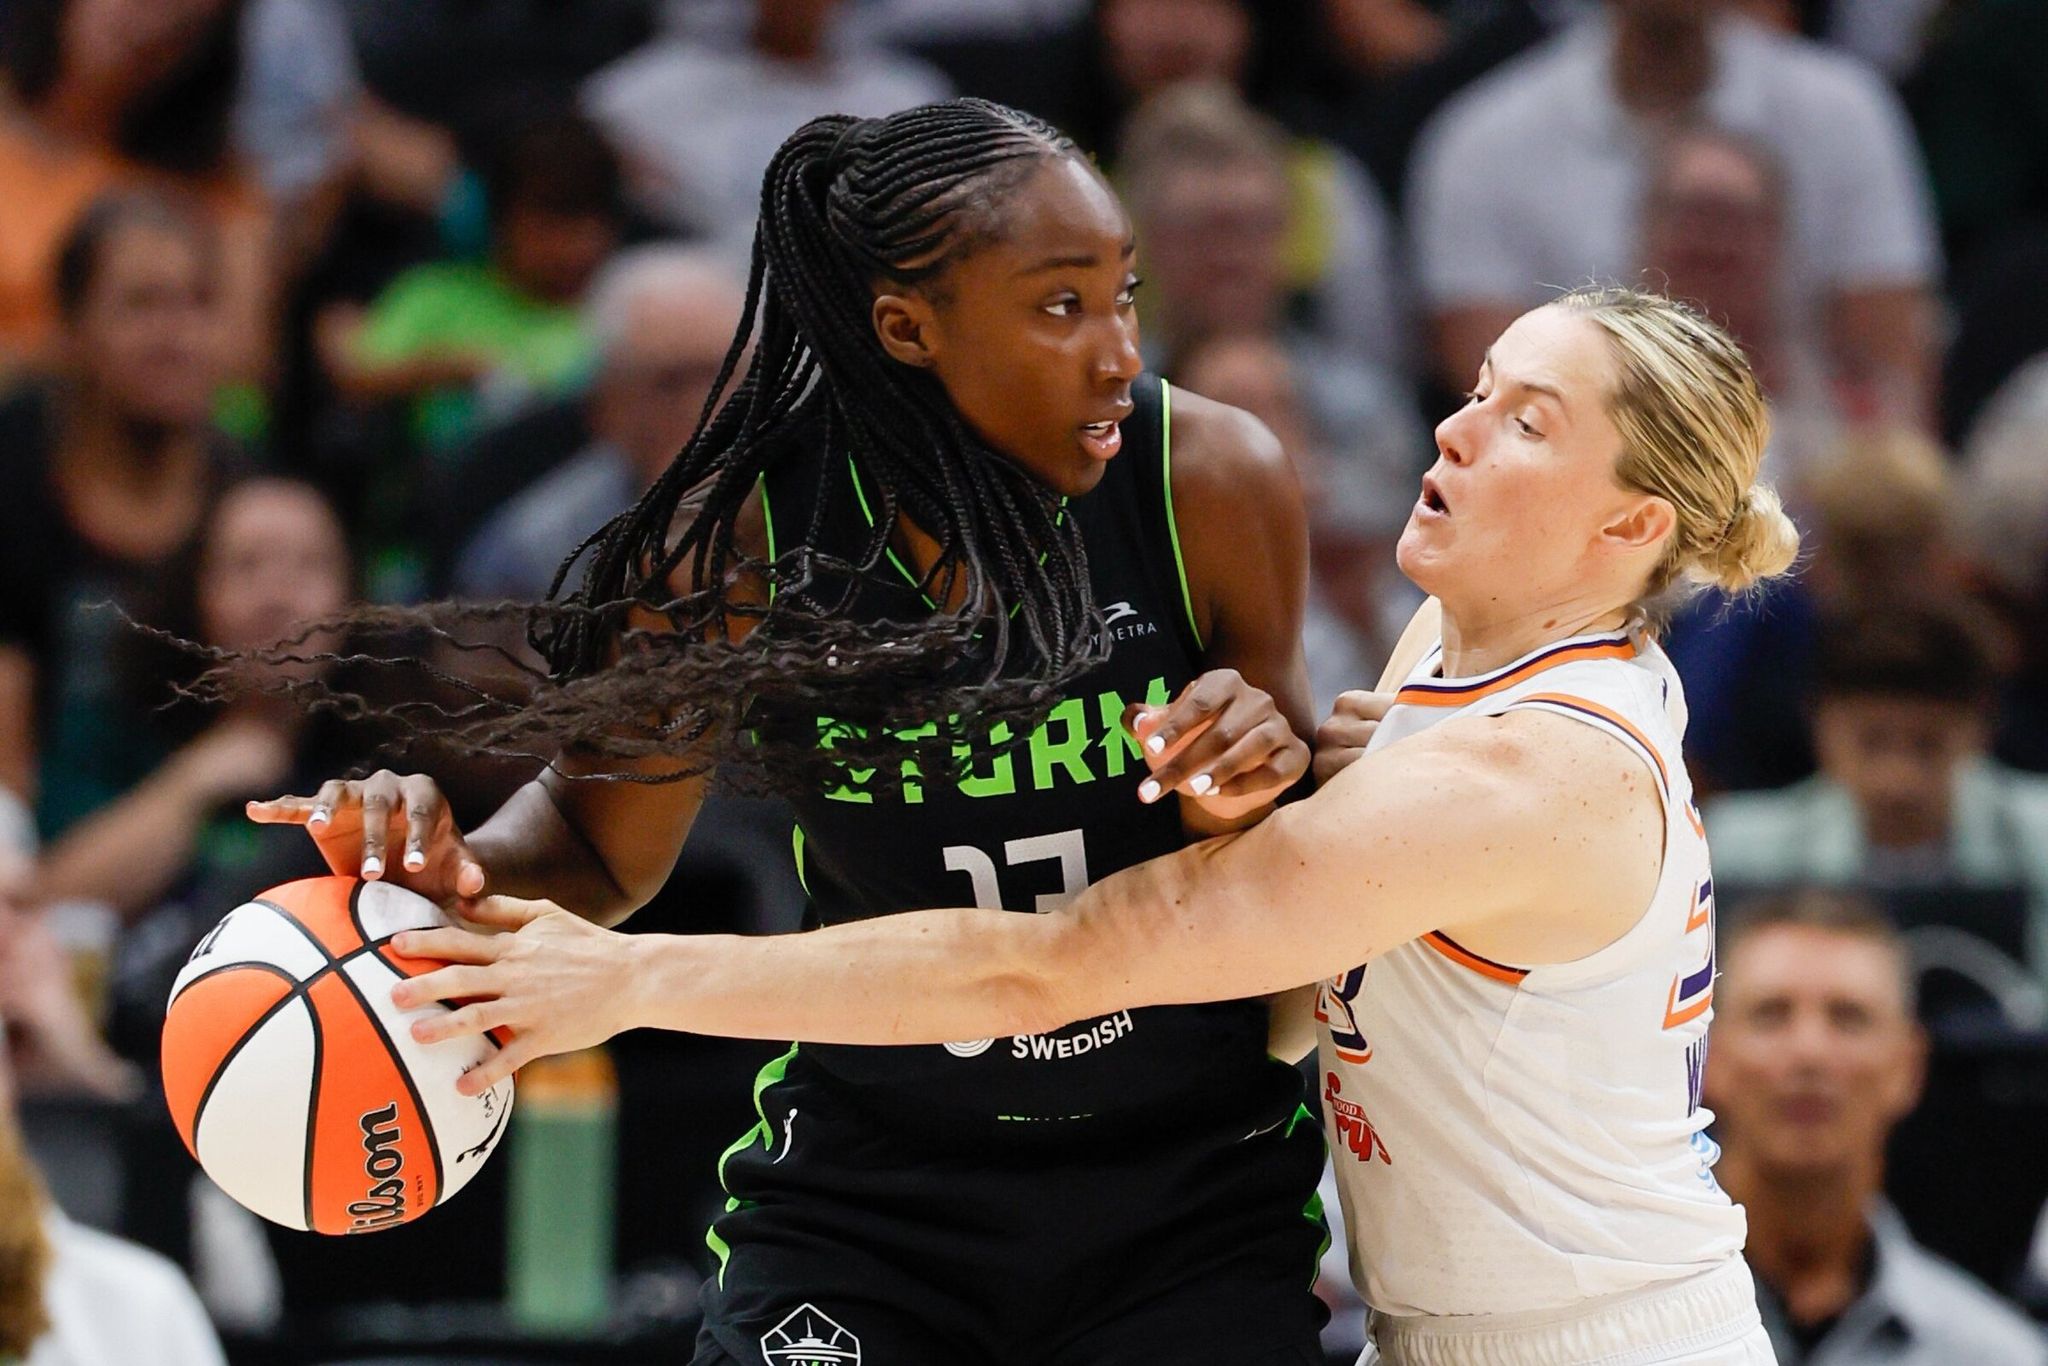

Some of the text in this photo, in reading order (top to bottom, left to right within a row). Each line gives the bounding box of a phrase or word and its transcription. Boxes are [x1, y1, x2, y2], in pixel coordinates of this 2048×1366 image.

[1089, 621, 1158, 646] YETRA
[1011, 1008, 1134, 1060] SWEDISH
[345, 1101, 408, 1235] ilson
